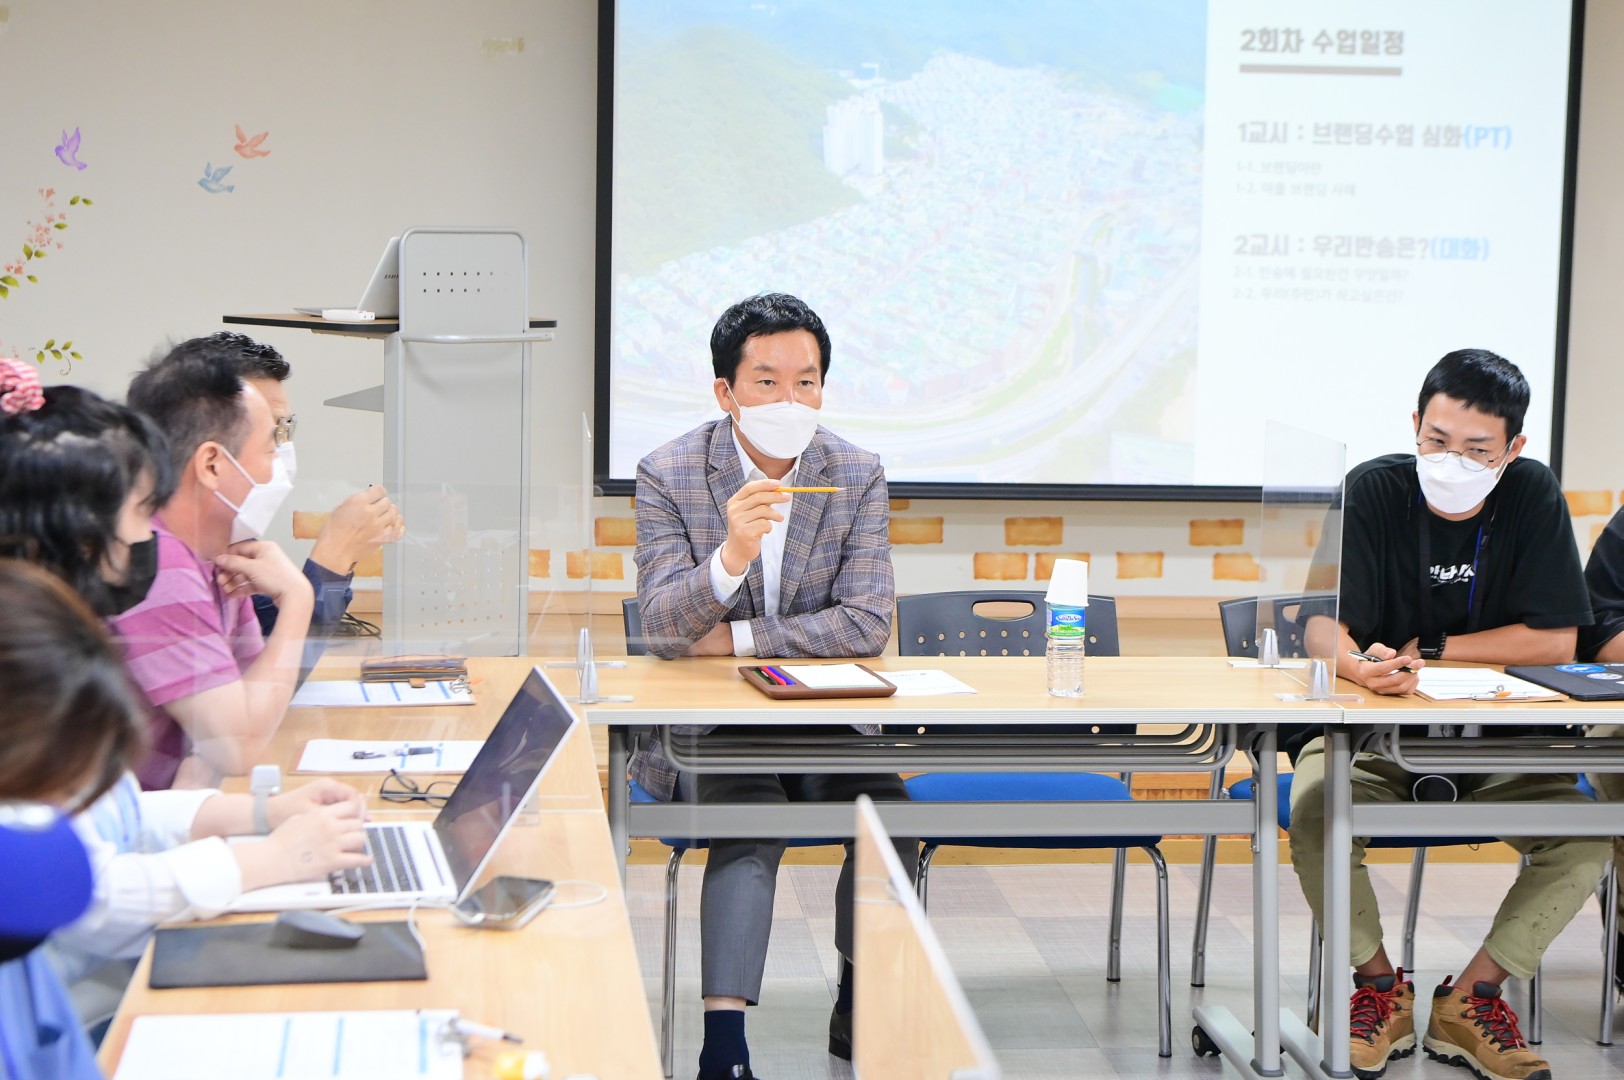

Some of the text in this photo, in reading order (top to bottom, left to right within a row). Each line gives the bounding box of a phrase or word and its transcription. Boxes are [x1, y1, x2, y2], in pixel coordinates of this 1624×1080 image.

[1240, 26, 1405, 55] 2회차 수업일정
[1237, 121, 1288, 144] 1교시
[1312, 122, 1415, 147] 브랜딩수업
[1233, 234, 1289, 257] 2교시
